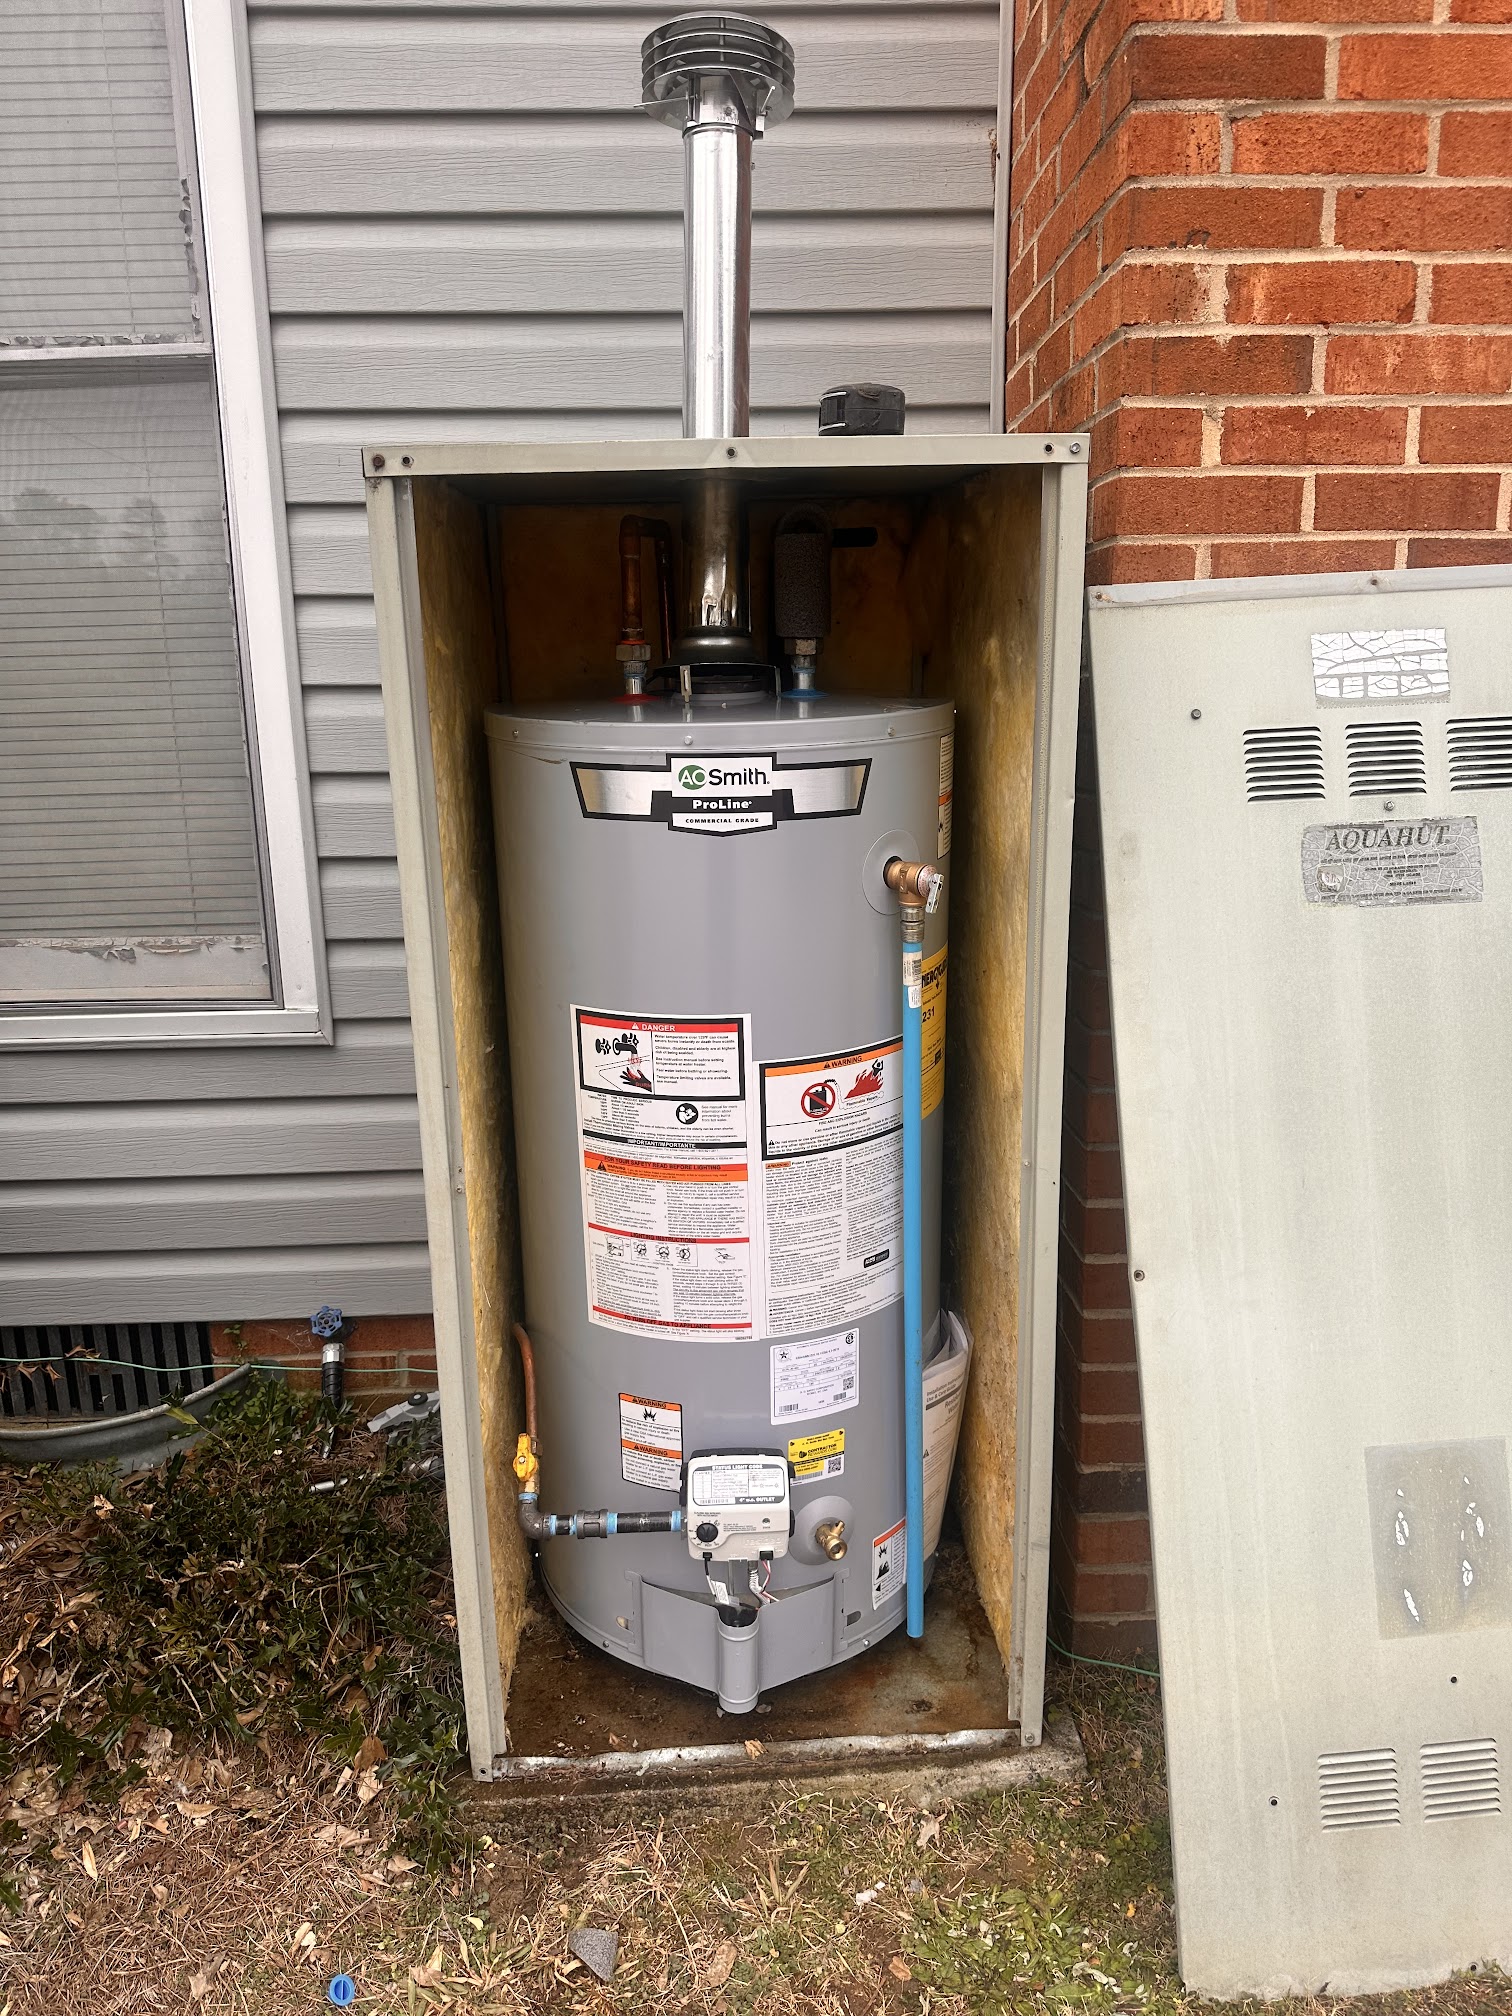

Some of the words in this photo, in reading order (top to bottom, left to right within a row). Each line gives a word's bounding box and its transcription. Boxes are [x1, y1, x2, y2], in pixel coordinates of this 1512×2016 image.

[1325, 825, 1449, 854] AQUAHUT
[642, 1023, 676, 1032] DANGER
[831, 1056, 862, 1068] WARNING
[638, 1398, 667, 1408] WARNING
[640, 1446, 668, 1456] WARNING
